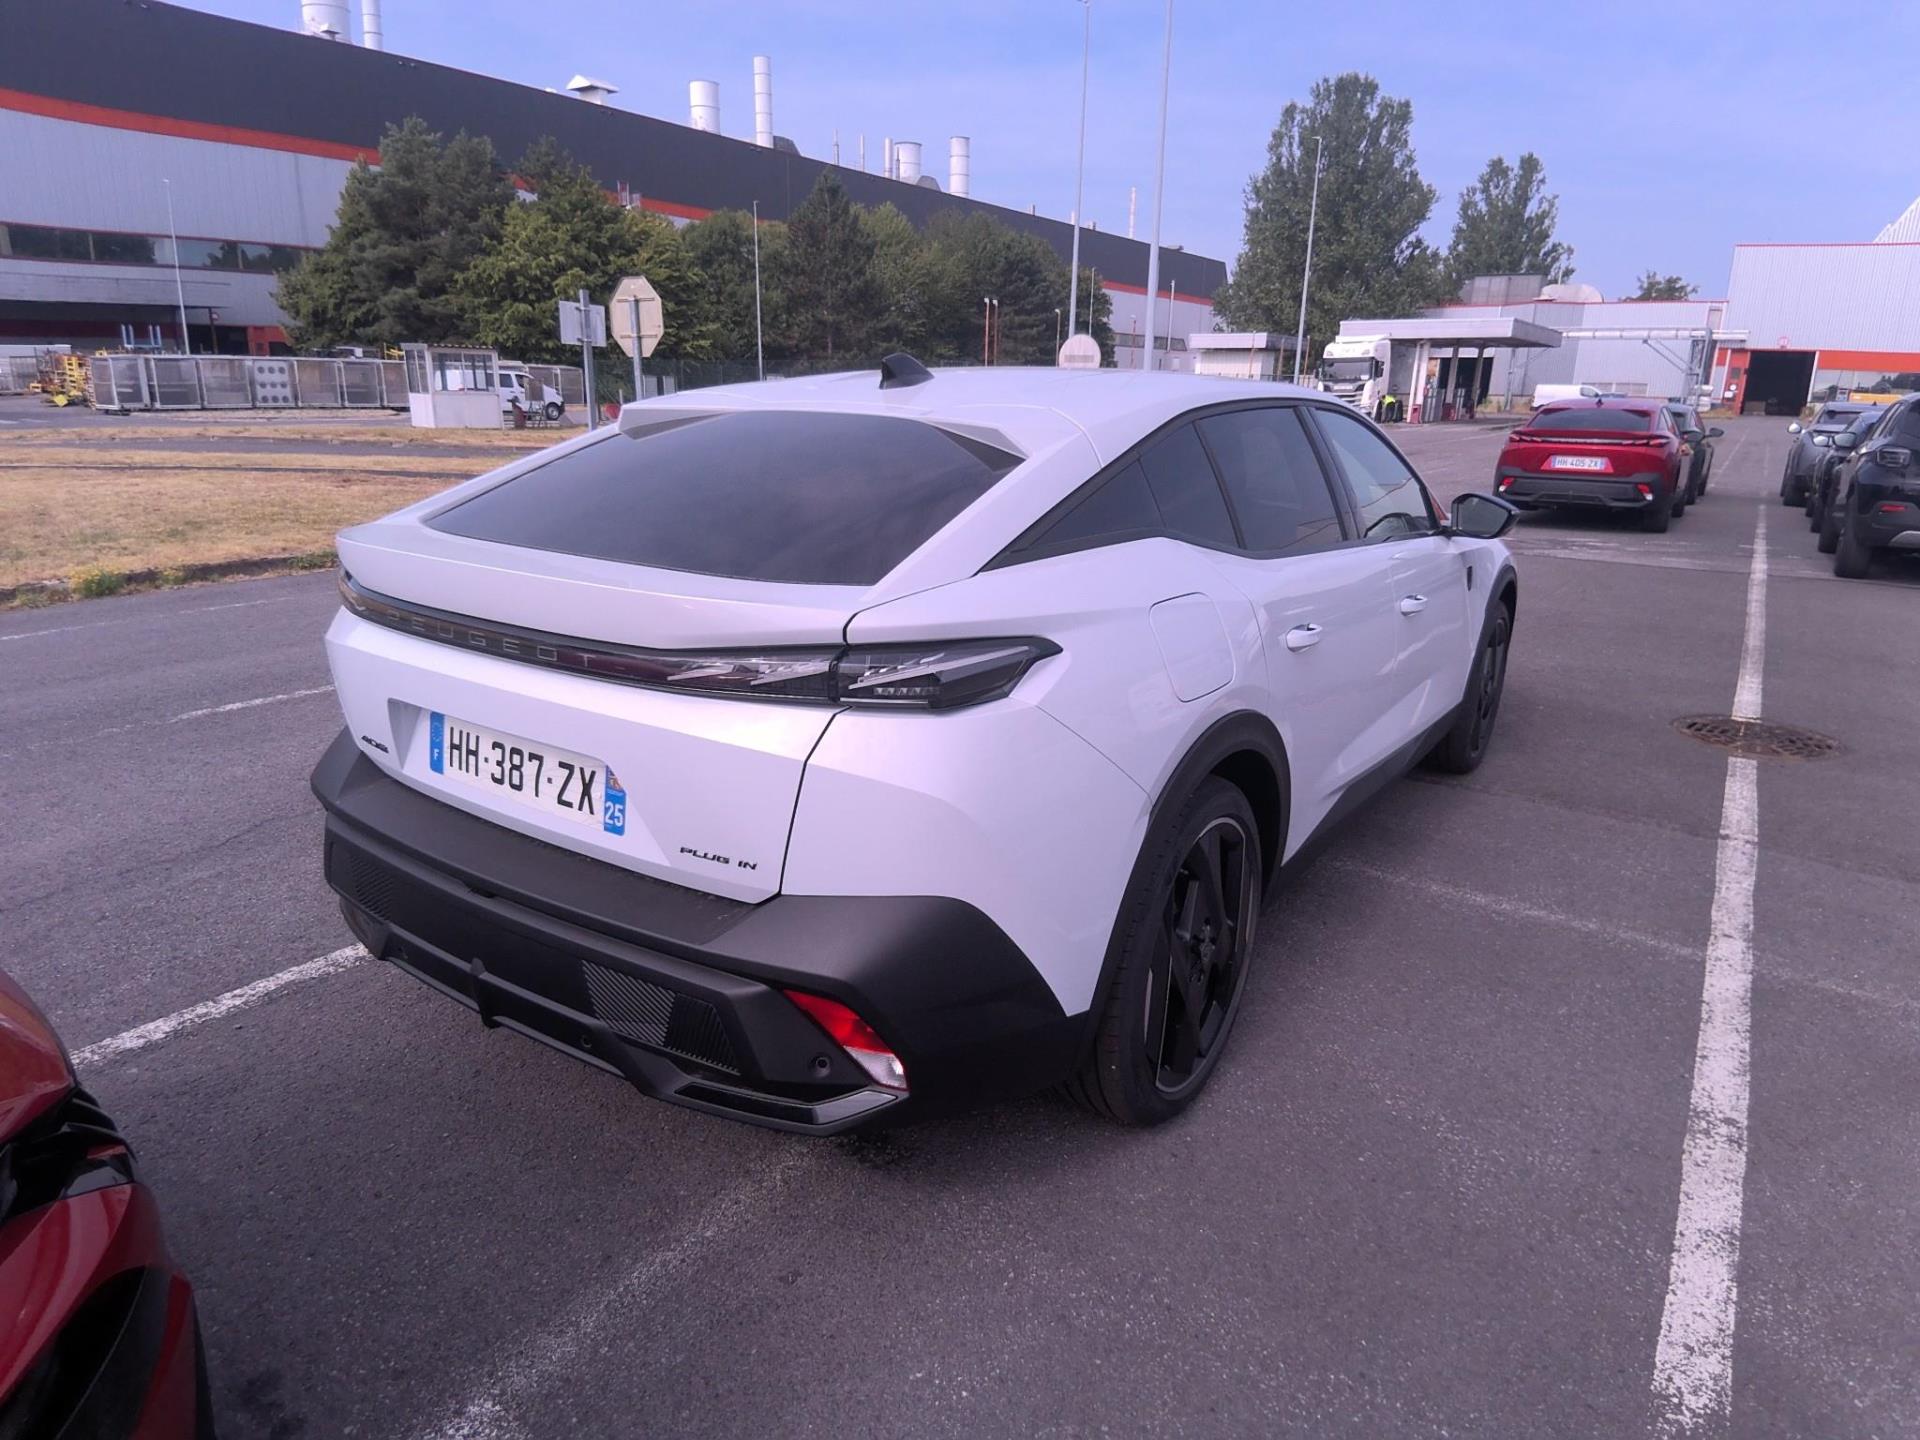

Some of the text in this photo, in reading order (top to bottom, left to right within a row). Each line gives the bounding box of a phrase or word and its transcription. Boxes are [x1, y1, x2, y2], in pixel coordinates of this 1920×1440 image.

[385, 609, 596, 667] PEUGEOT
[433, 748, 439, 760] F
[605, 801, 624, 827] 25
[680, 846, 757, 870] PLUG IN
